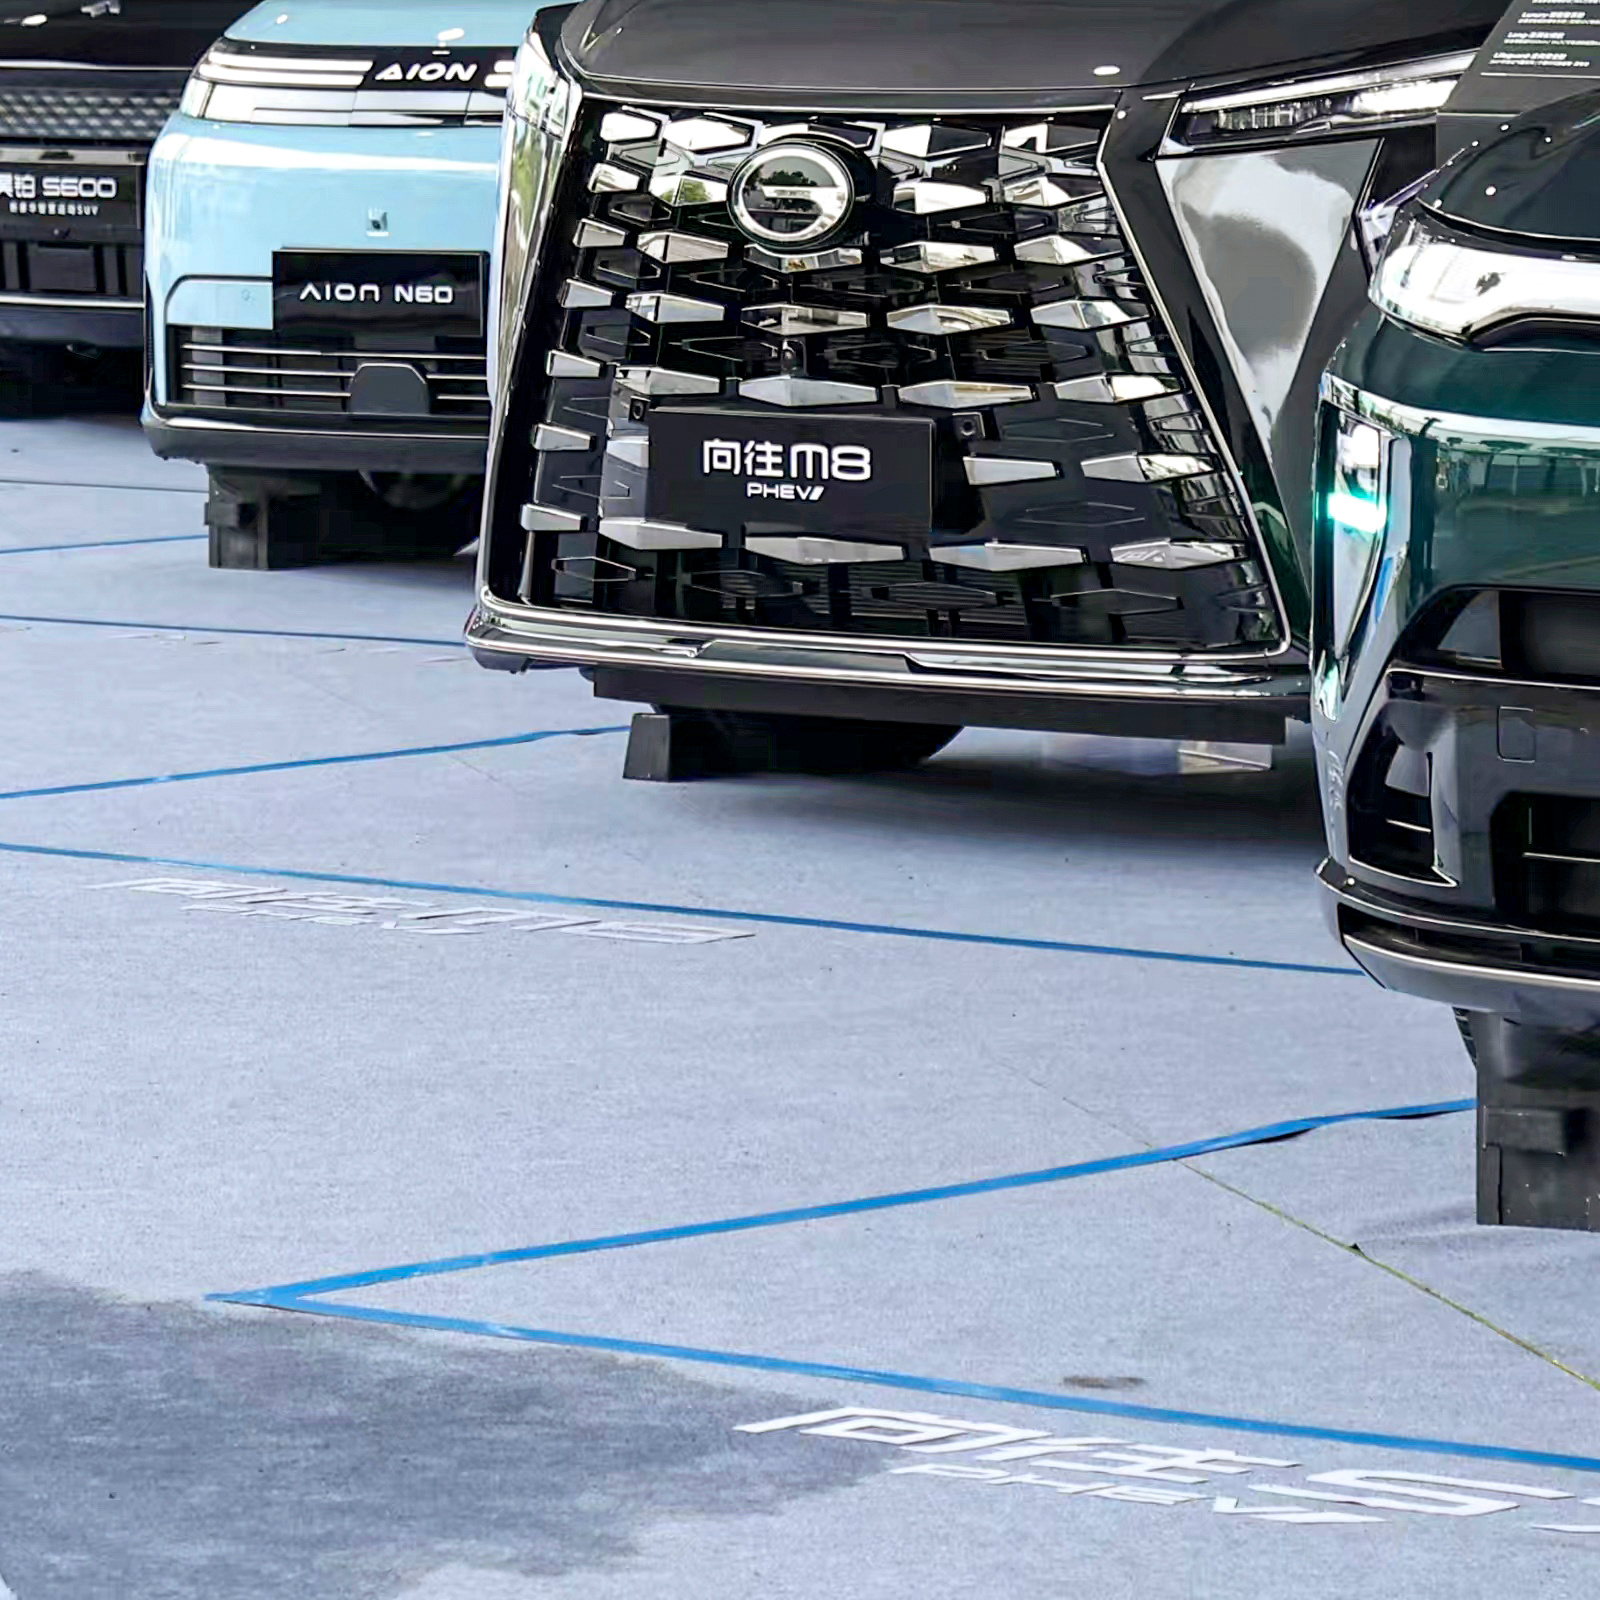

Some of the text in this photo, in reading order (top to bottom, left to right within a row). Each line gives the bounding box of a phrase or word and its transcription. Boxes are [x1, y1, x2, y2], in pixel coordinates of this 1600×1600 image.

[374, 62, 478, 82] AION
[42, 175, 118, 199] S600
[298, 283, 454, 305] AION N60
[702, 438, 872, 483] 向往M8
